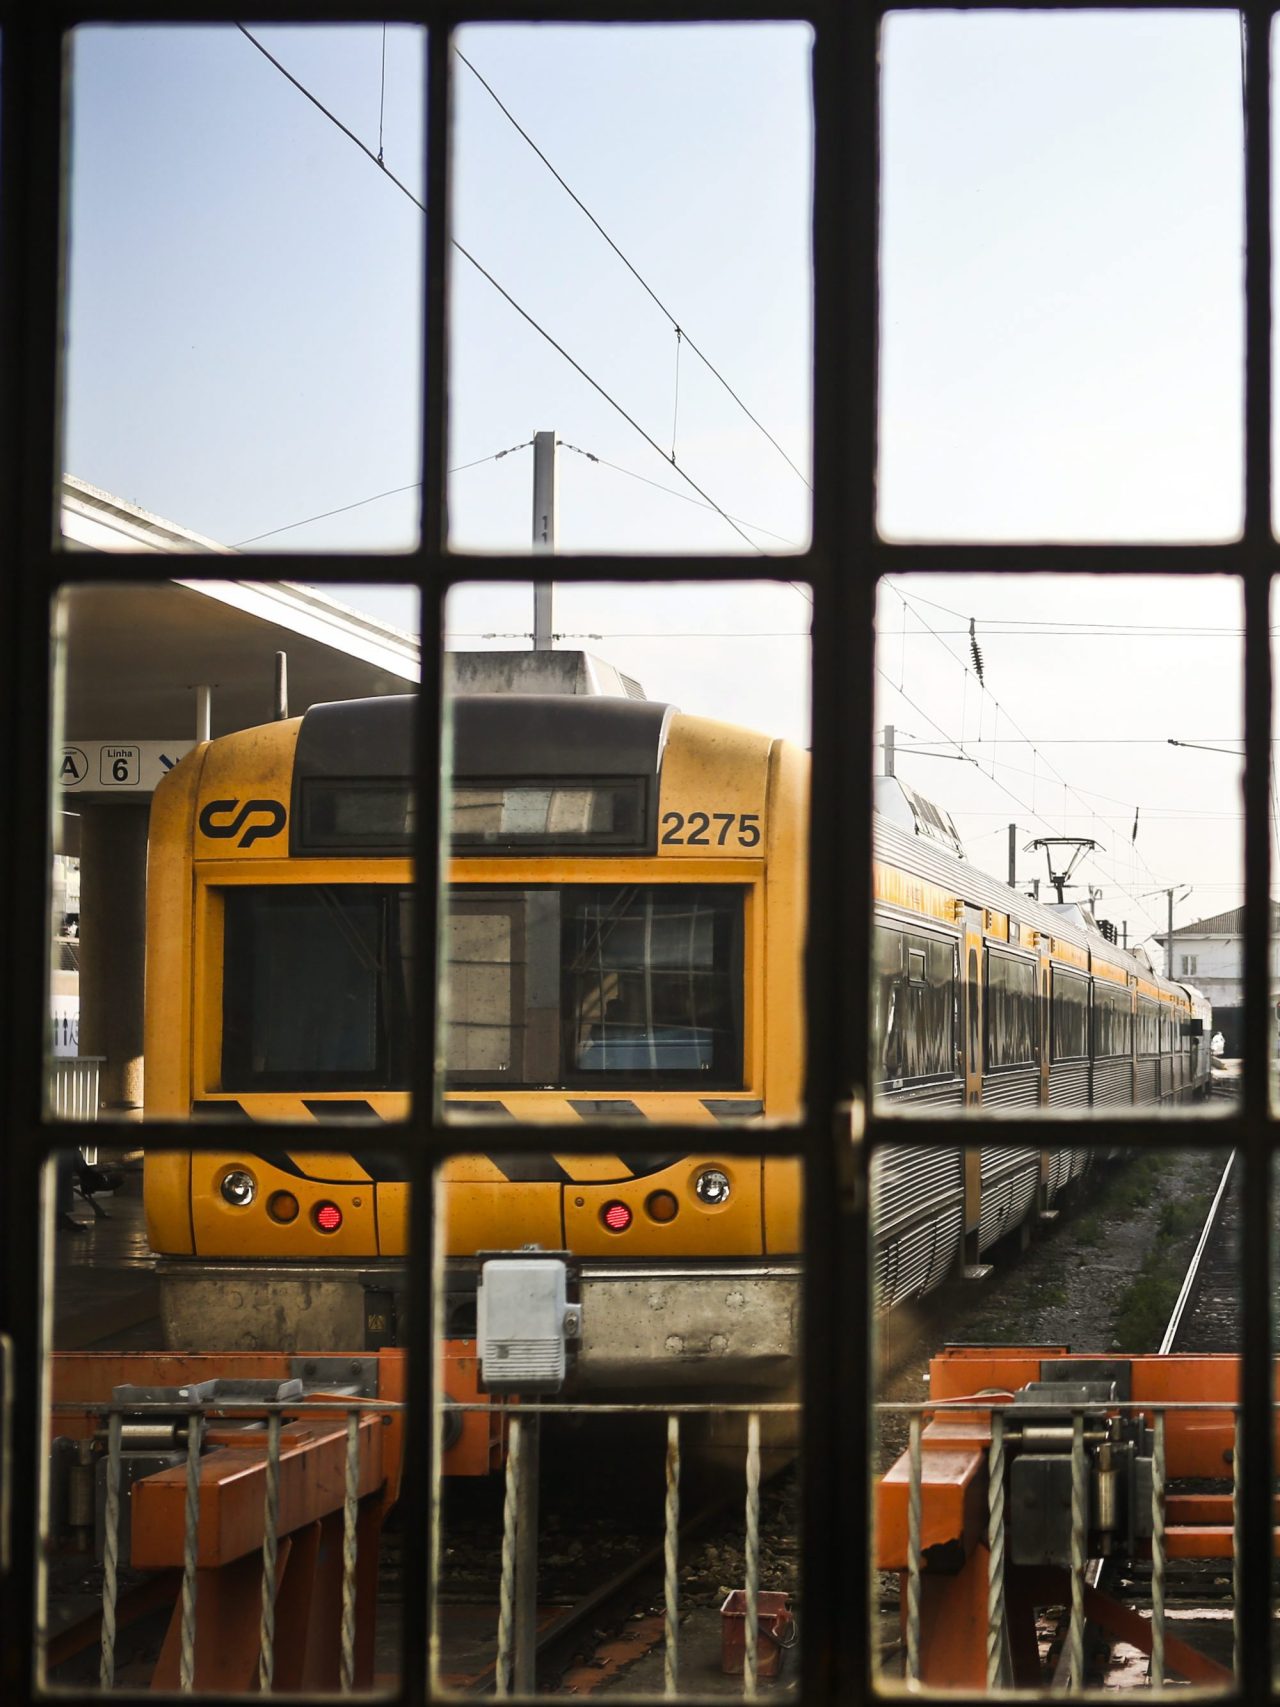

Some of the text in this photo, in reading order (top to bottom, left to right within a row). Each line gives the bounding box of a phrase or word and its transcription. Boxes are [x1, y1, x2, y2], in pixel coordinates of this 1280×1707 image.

[107, 749, 133, 758] Linha
[60, 756, 79, 778] A
[112, 759, 129, 782] 6
[661, 812, 760, 847] 2275
